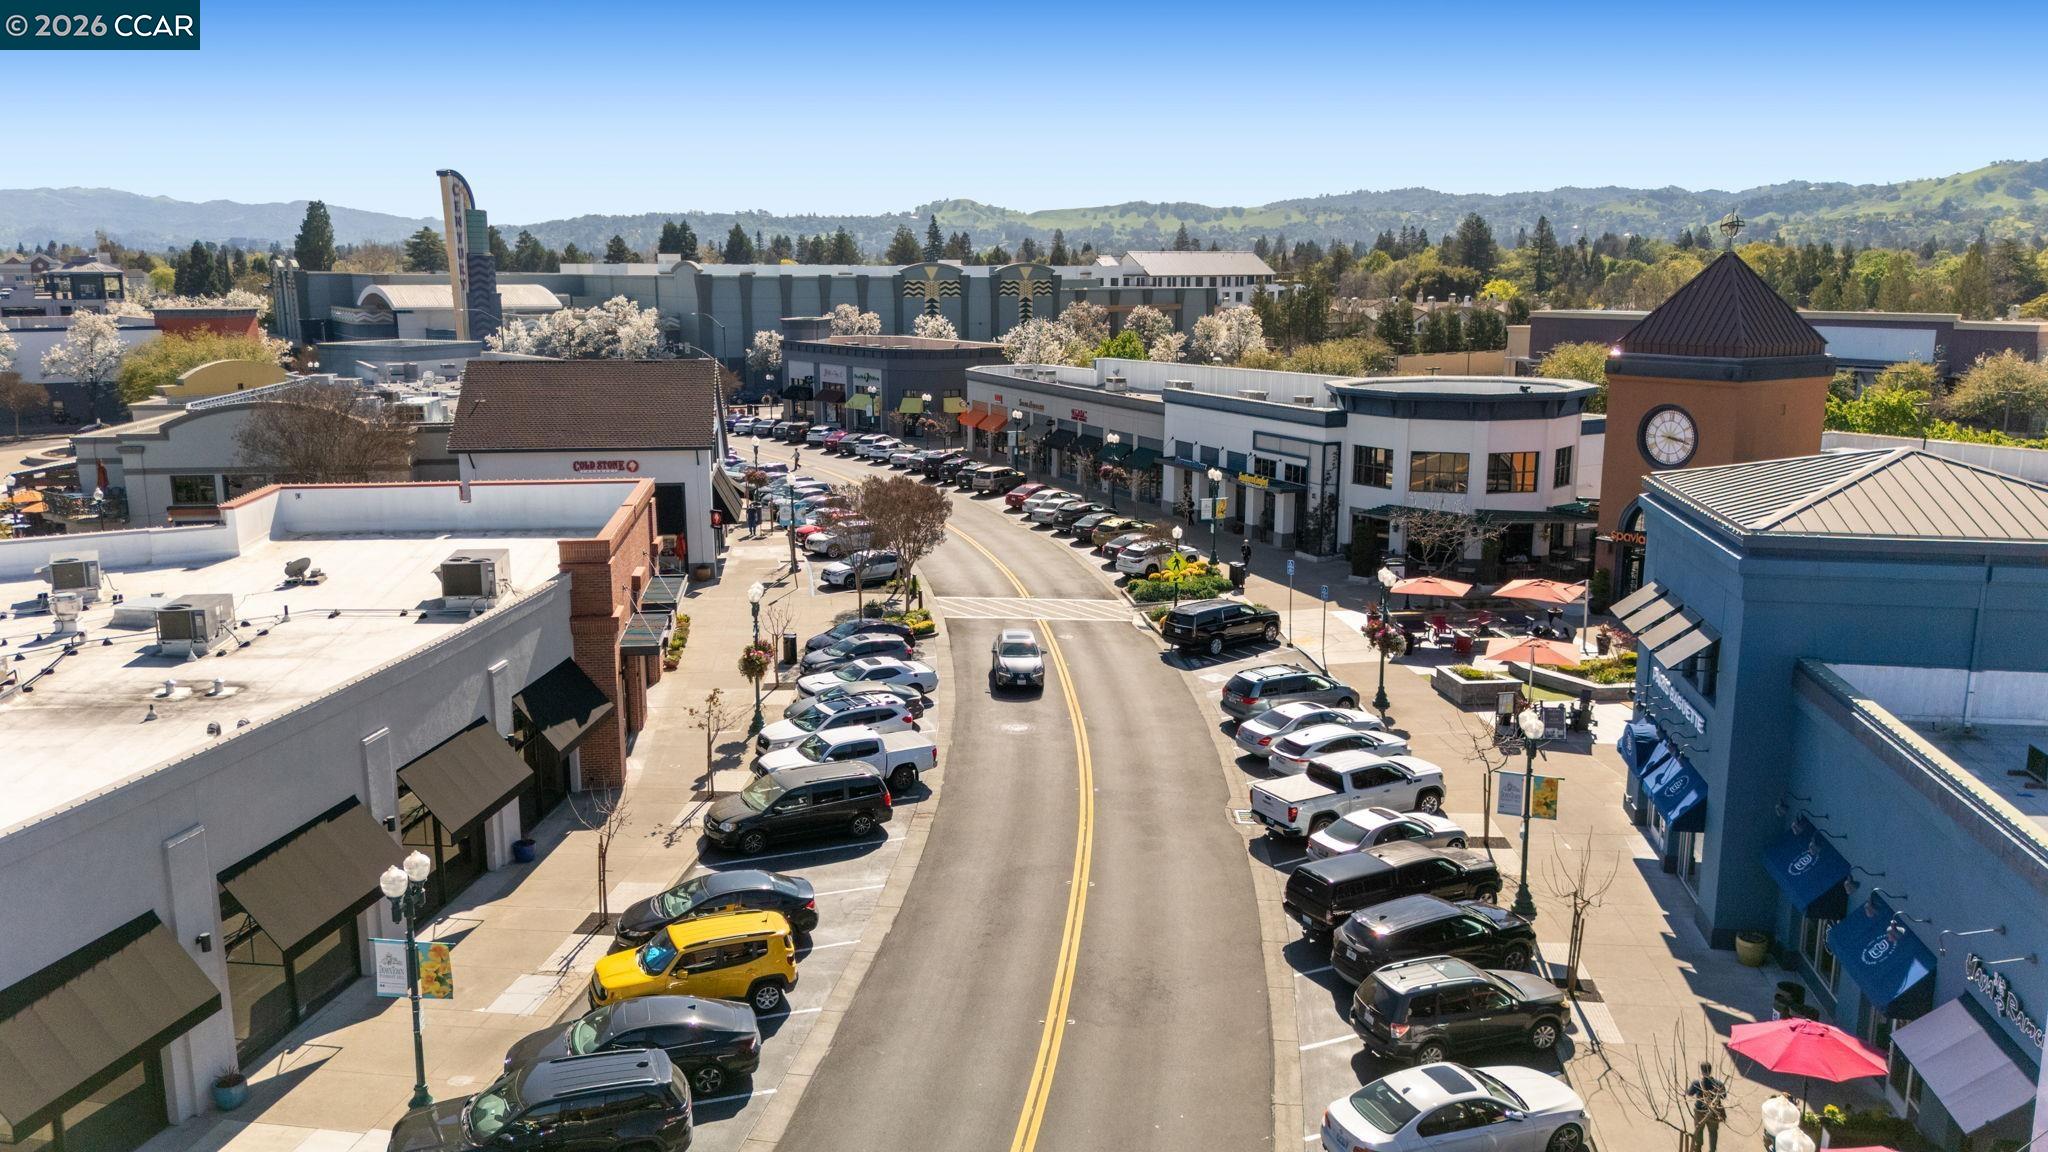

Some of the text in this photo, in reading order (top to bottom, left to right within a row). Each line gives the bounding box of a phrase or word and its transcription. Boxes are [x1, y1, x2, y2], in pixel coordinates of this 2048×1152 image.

[452, 183, 467, 291] CENTURY
[573, 460, 595, 472] COLD
[596, 460, 625, 471] STONE
[1610, 530, 1647, 545] spavia
